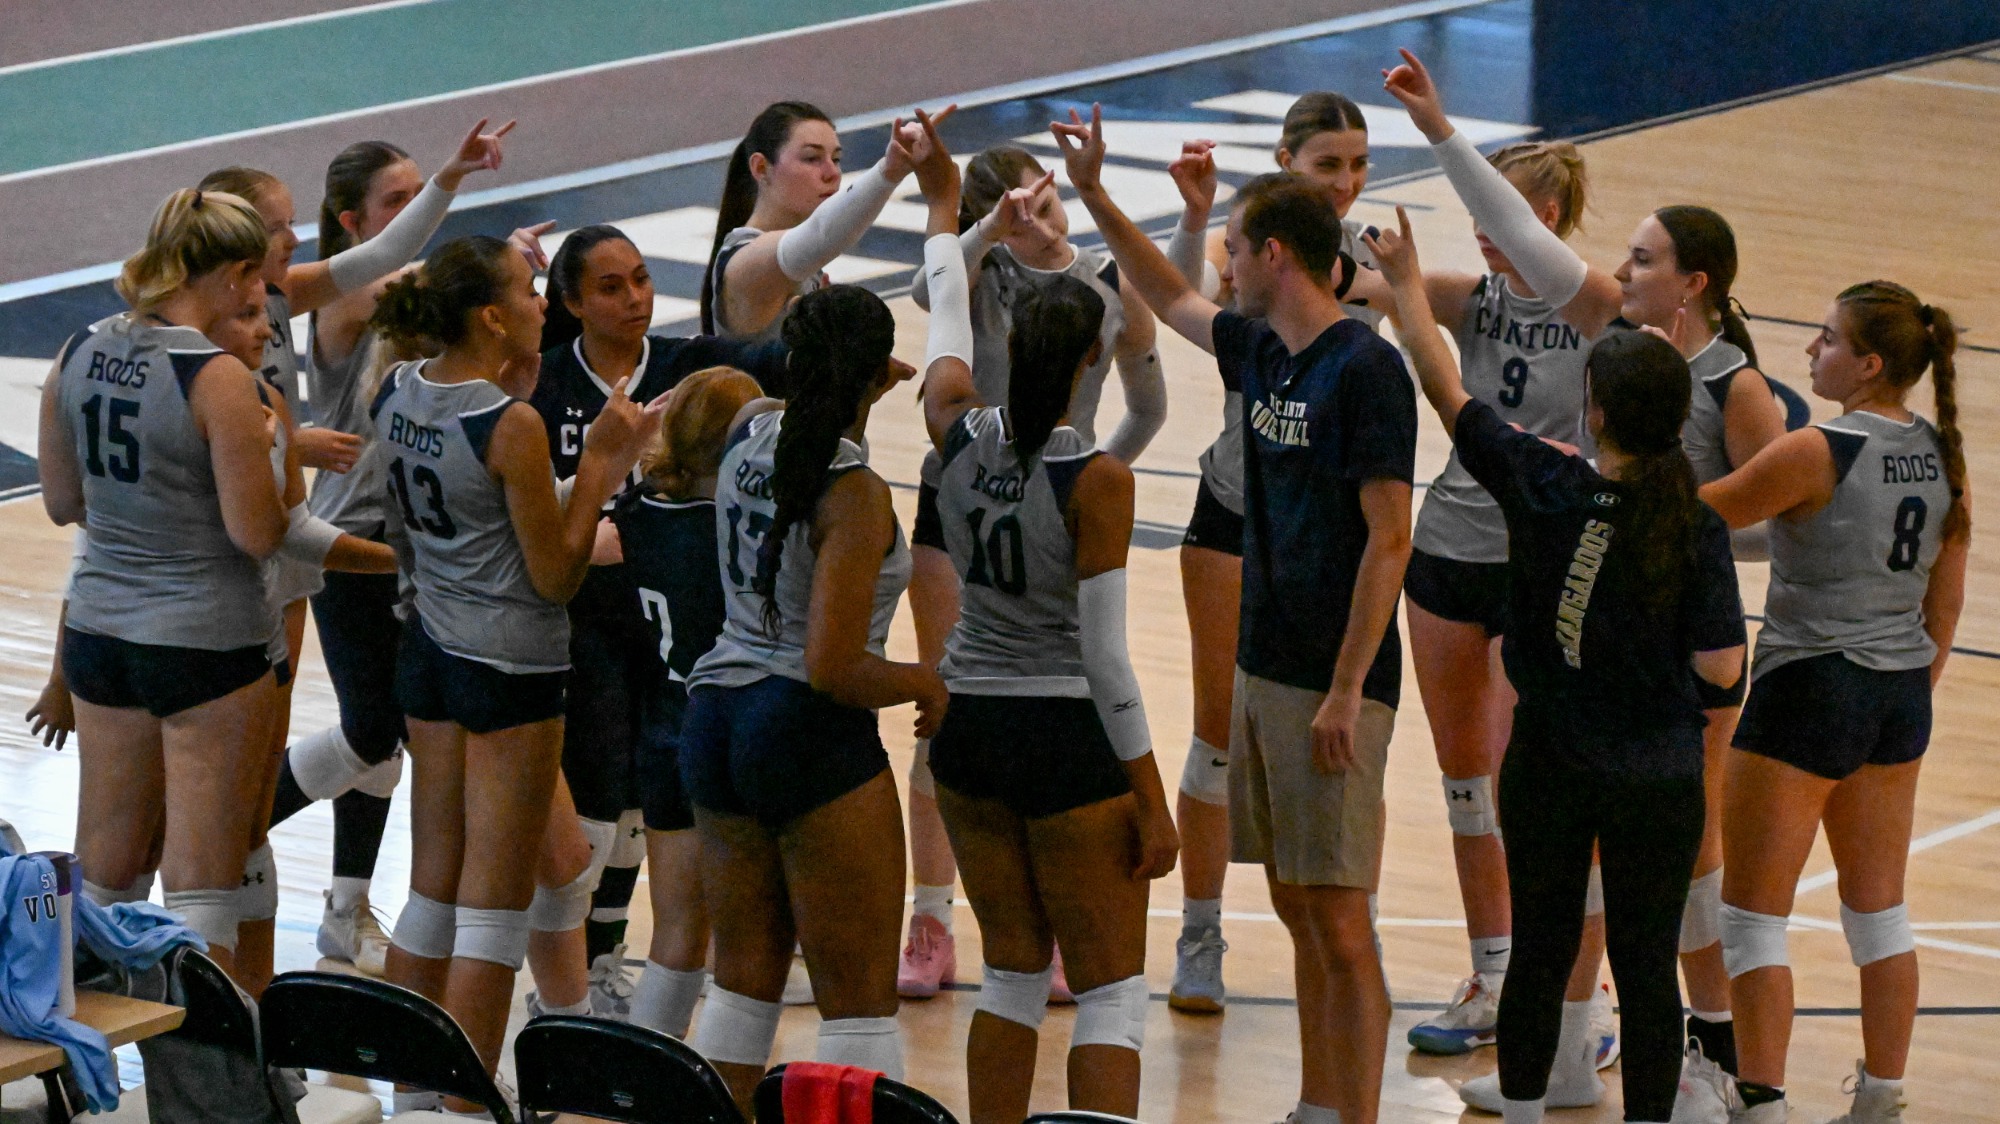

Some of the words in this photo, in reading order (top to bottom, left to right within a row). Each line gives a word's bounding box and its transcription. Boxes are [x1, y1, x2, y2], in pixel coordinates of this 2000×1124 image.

[1475, 307, 1581, 351] CANTON
[86, 350, 150, 389] ROOS
[1499, 357, 1528, 408] 9
[81, 393, 141, 484] 15
[388, 411, 445, 459] ROOS
[735, 458, 775, 501] ROO
[970, 463, 1025, 503] ROO
[1882, 452, 1939, 484] ROOS
[389, 456, 458, 541] 13
[965, 506, 1027, 597] 10
[1886, 496, 1928, 573] 8
[1555, 518, 1616, 670] KANGAROOS
